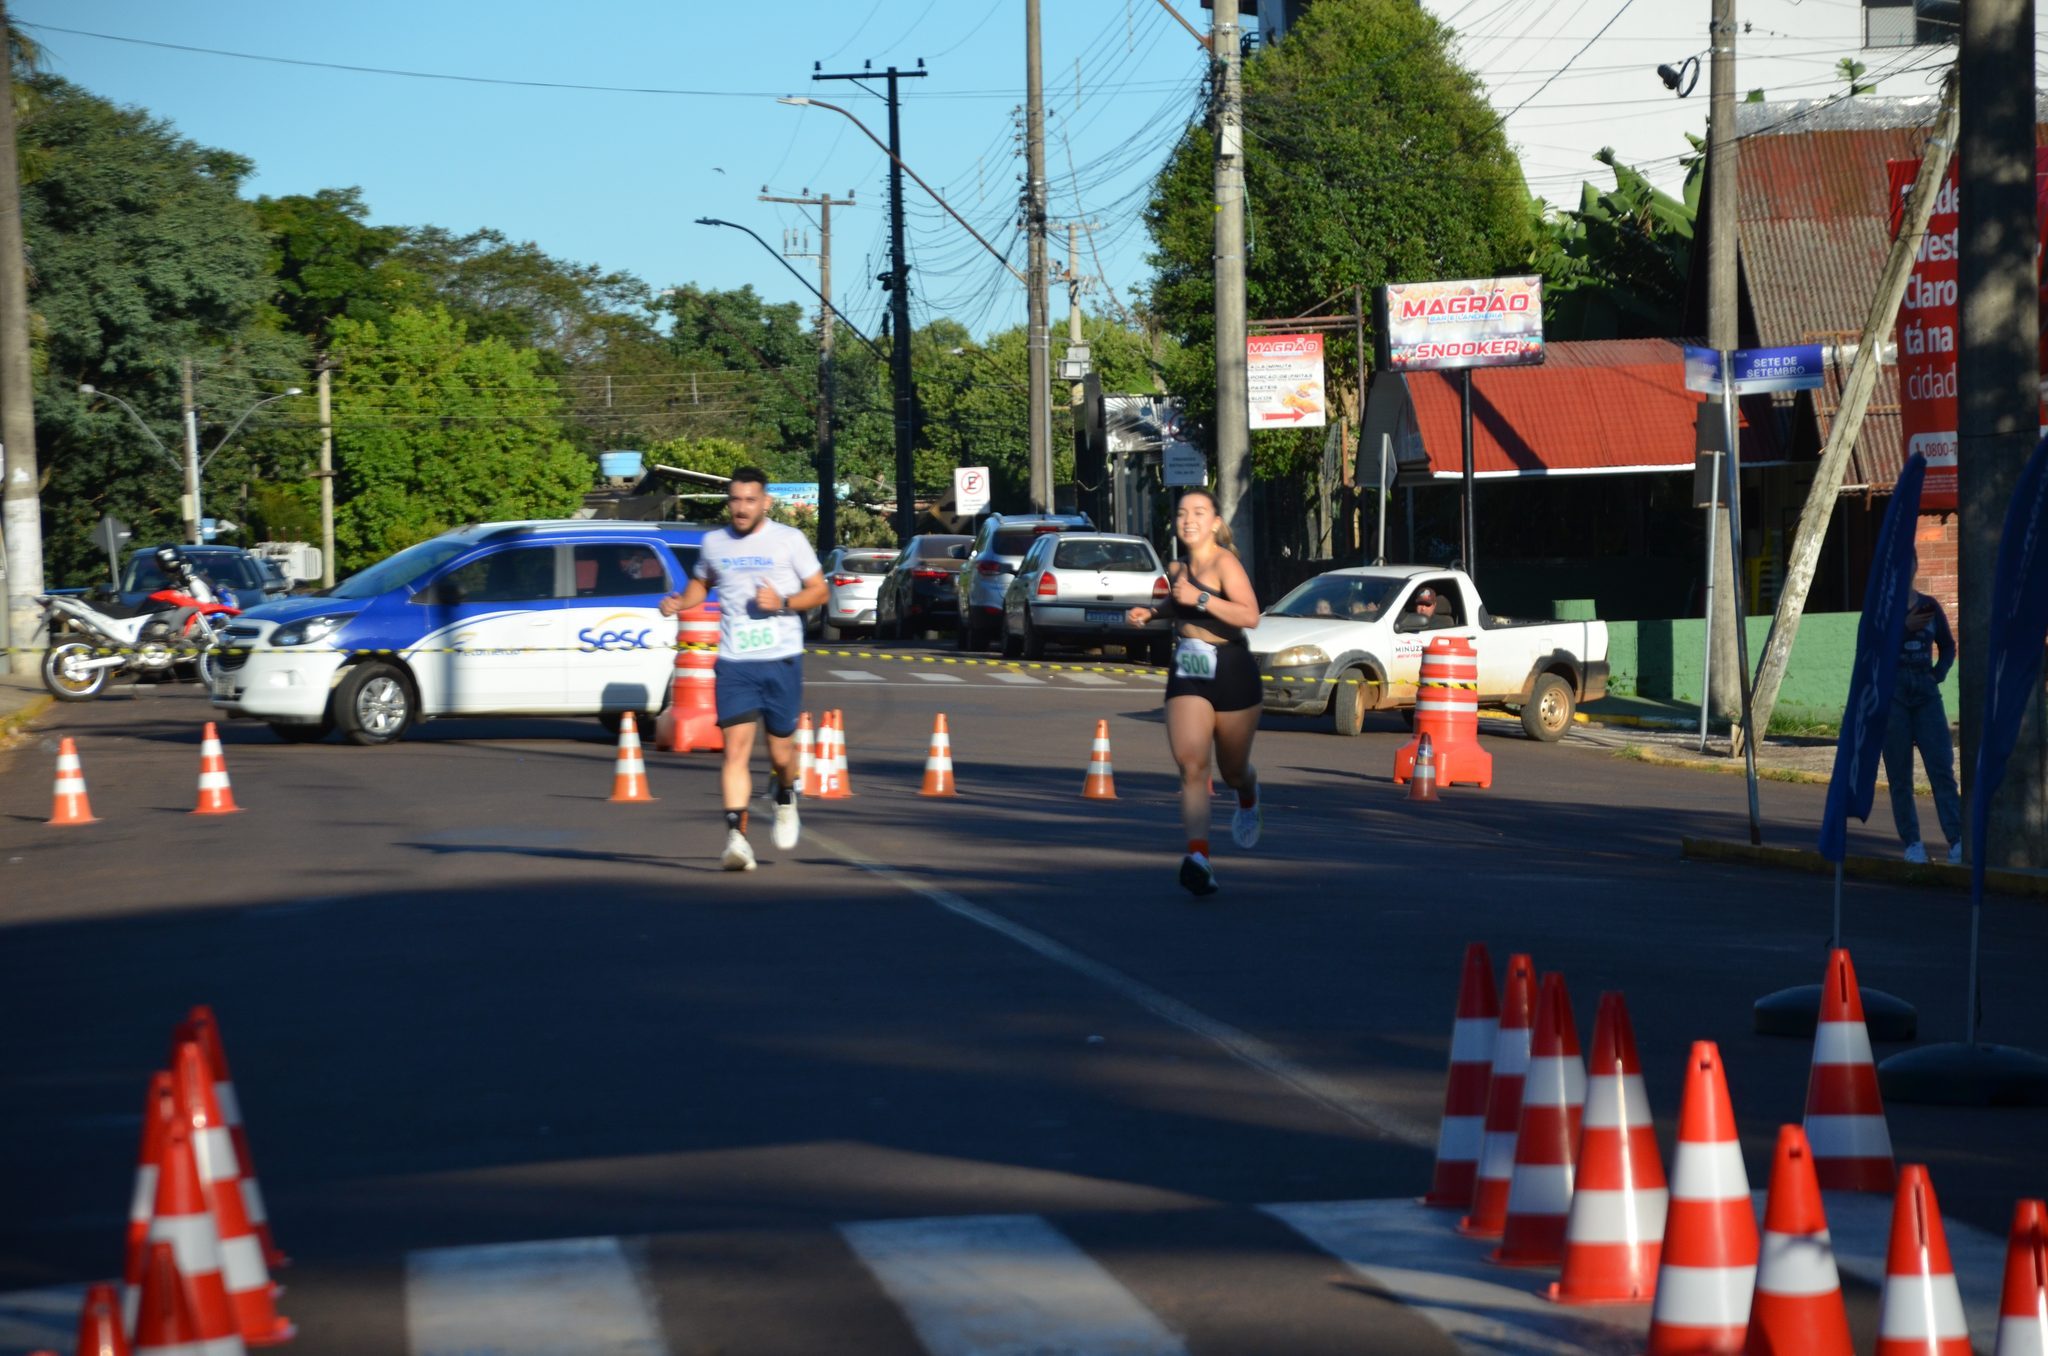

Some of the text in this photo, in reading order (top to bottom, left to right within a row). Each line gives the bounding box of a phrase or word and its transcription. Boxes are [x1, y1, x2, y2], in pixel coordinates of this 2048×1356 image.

[1904, 272, 1958, 309] Claro
[1402, 288, 1530, 318] MAGRÃO
[1249, 338, 1317, 354] MAGRÃO
[1905, 319, 1953, 354] tá na
[1416, 340, 1519, 359] SNOOKER
[1746, 365, 1806, 378] SETEMBRO
[1753, 356, 1798, 368] SETE DE
[1909, 362, 1958, 400] cidad
[736, 627, 774, 649] 366
[1182, 653, 1210, 675] 500
